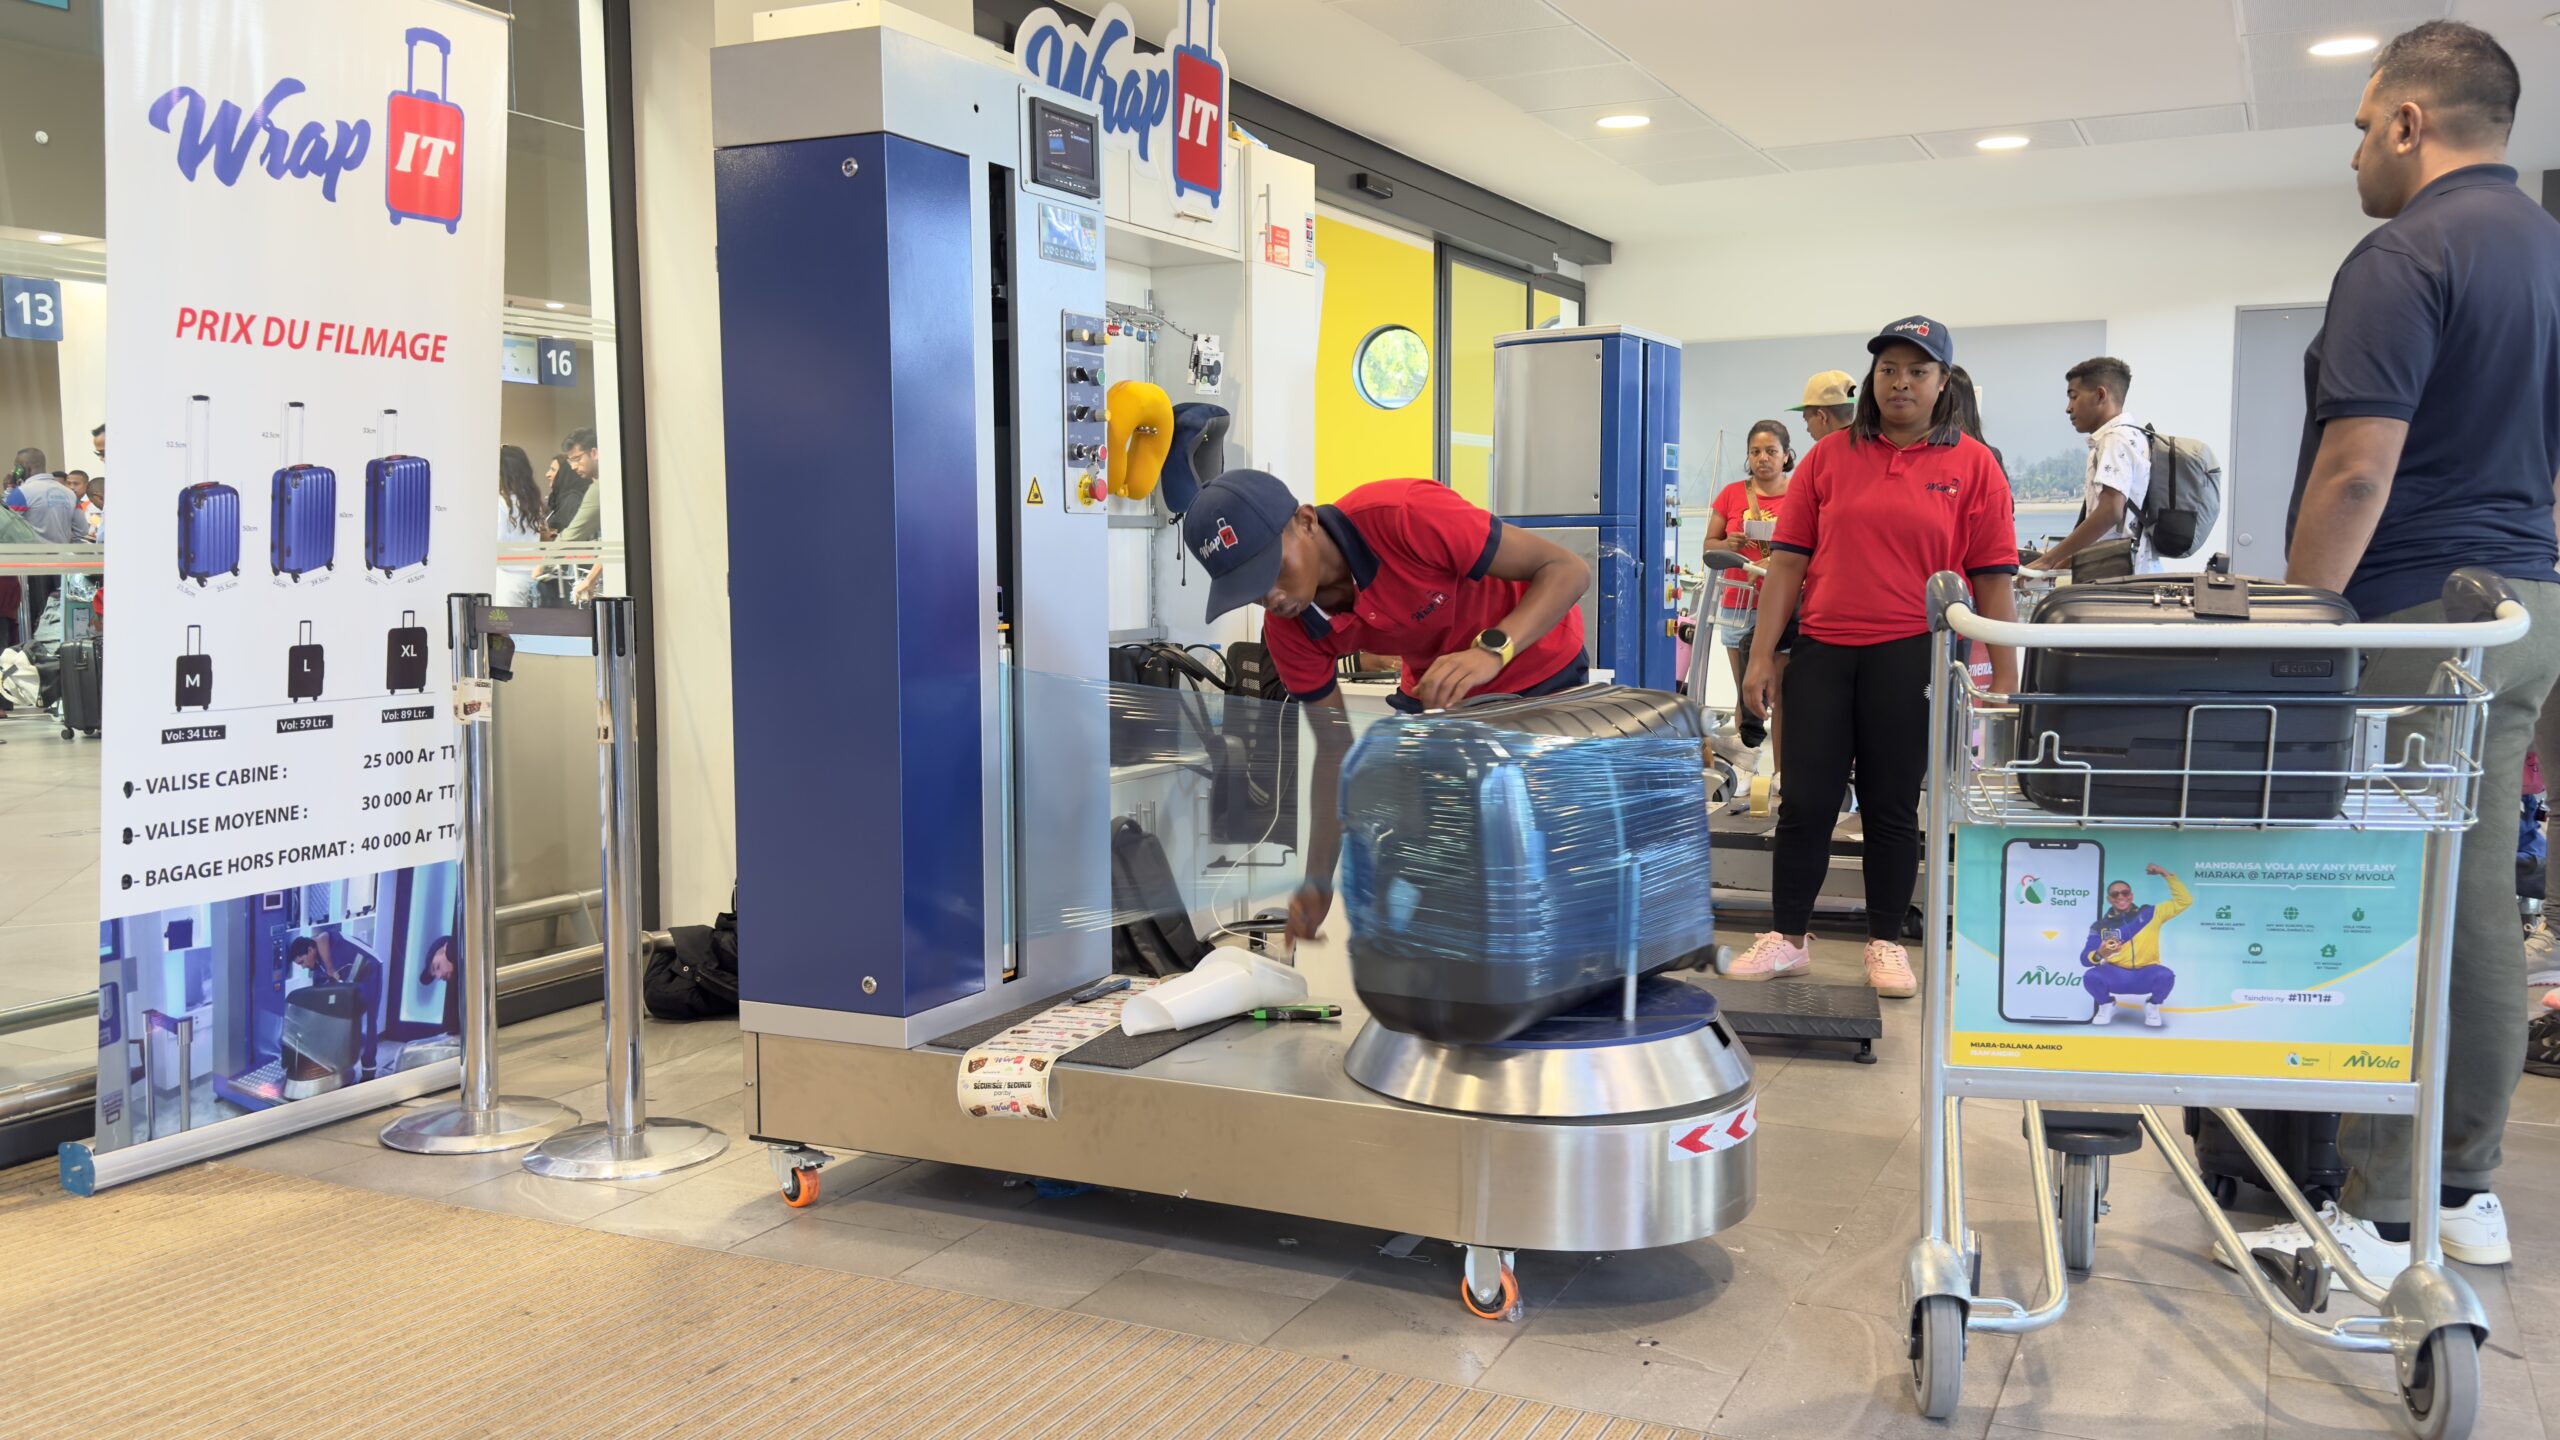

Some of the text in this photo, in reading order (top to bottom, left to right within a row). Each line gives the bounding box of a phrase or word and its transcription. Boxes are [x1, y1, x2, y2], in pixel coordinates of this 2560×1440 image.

[1025, 19, 1218, 162] Wrap IT
[148, 77, 456, 202] Wrap IT
[14, 292, 54, 328] 13
[176, 307, 448, 364] PRIX DU FILMAGE
[546, 349, 572, 377] 16
[1199, 535, 1220, 559] Wrap
[401, 645, 417, 657] XL
[304, 659, 311, 672] L
[185, 674, 200, 688] M
[383, 708, 428, 720] Vol: 89 Ltr.
[280, 717, 329, 730] Vol: 59 Ltr.
[165, 728, 221, 741] Vol: 34 Ltr.
[145, 772, 211, 796] VALISE
[215, 764, 279, 788] CABINE
[363, 753, 382, 769] 25
[386, 750, 414, 766] 000
[417, 748, 435, 763] Ar
[441, 744, 456, 760] TT
[145, 818, 210, 842] VALISE
[214, 805, 300, 834] MOYENNE
[361, 795, 380, 811] 30
[384, 790, 412, 807] 000
[415, 788, 433, 803] Ar
[439, 784, 457, 800] TT
[145, 858, 223, 888] BAGAGE
[227, 852, 275, 874] HORS
[278, 841, 347, 867] FORMAT
[361, 836, 380, 852] 40
[384, 831, 411, 848] 000
[415, 828, 432, 843] Ar
[438, 823, 457, 839] TT
[2195, 862, 2262, 870] MANDRAISA
[2297, 863, 2320, 871] AVY
[2322, 863, 2346, 871] ANY
[2194, 871, 2395, 881] MIARAKA @ TAPTAP SEND SY MVOLA
[2050, 887, 2090, 898] Taptap
[2050, 898, 2077, 906] Send
[2017, 967, 2082, 986] MVola
[2244, 994, 2274, 1002] Tsindrio
[2342, 1052, 2400, 1069] MVola
